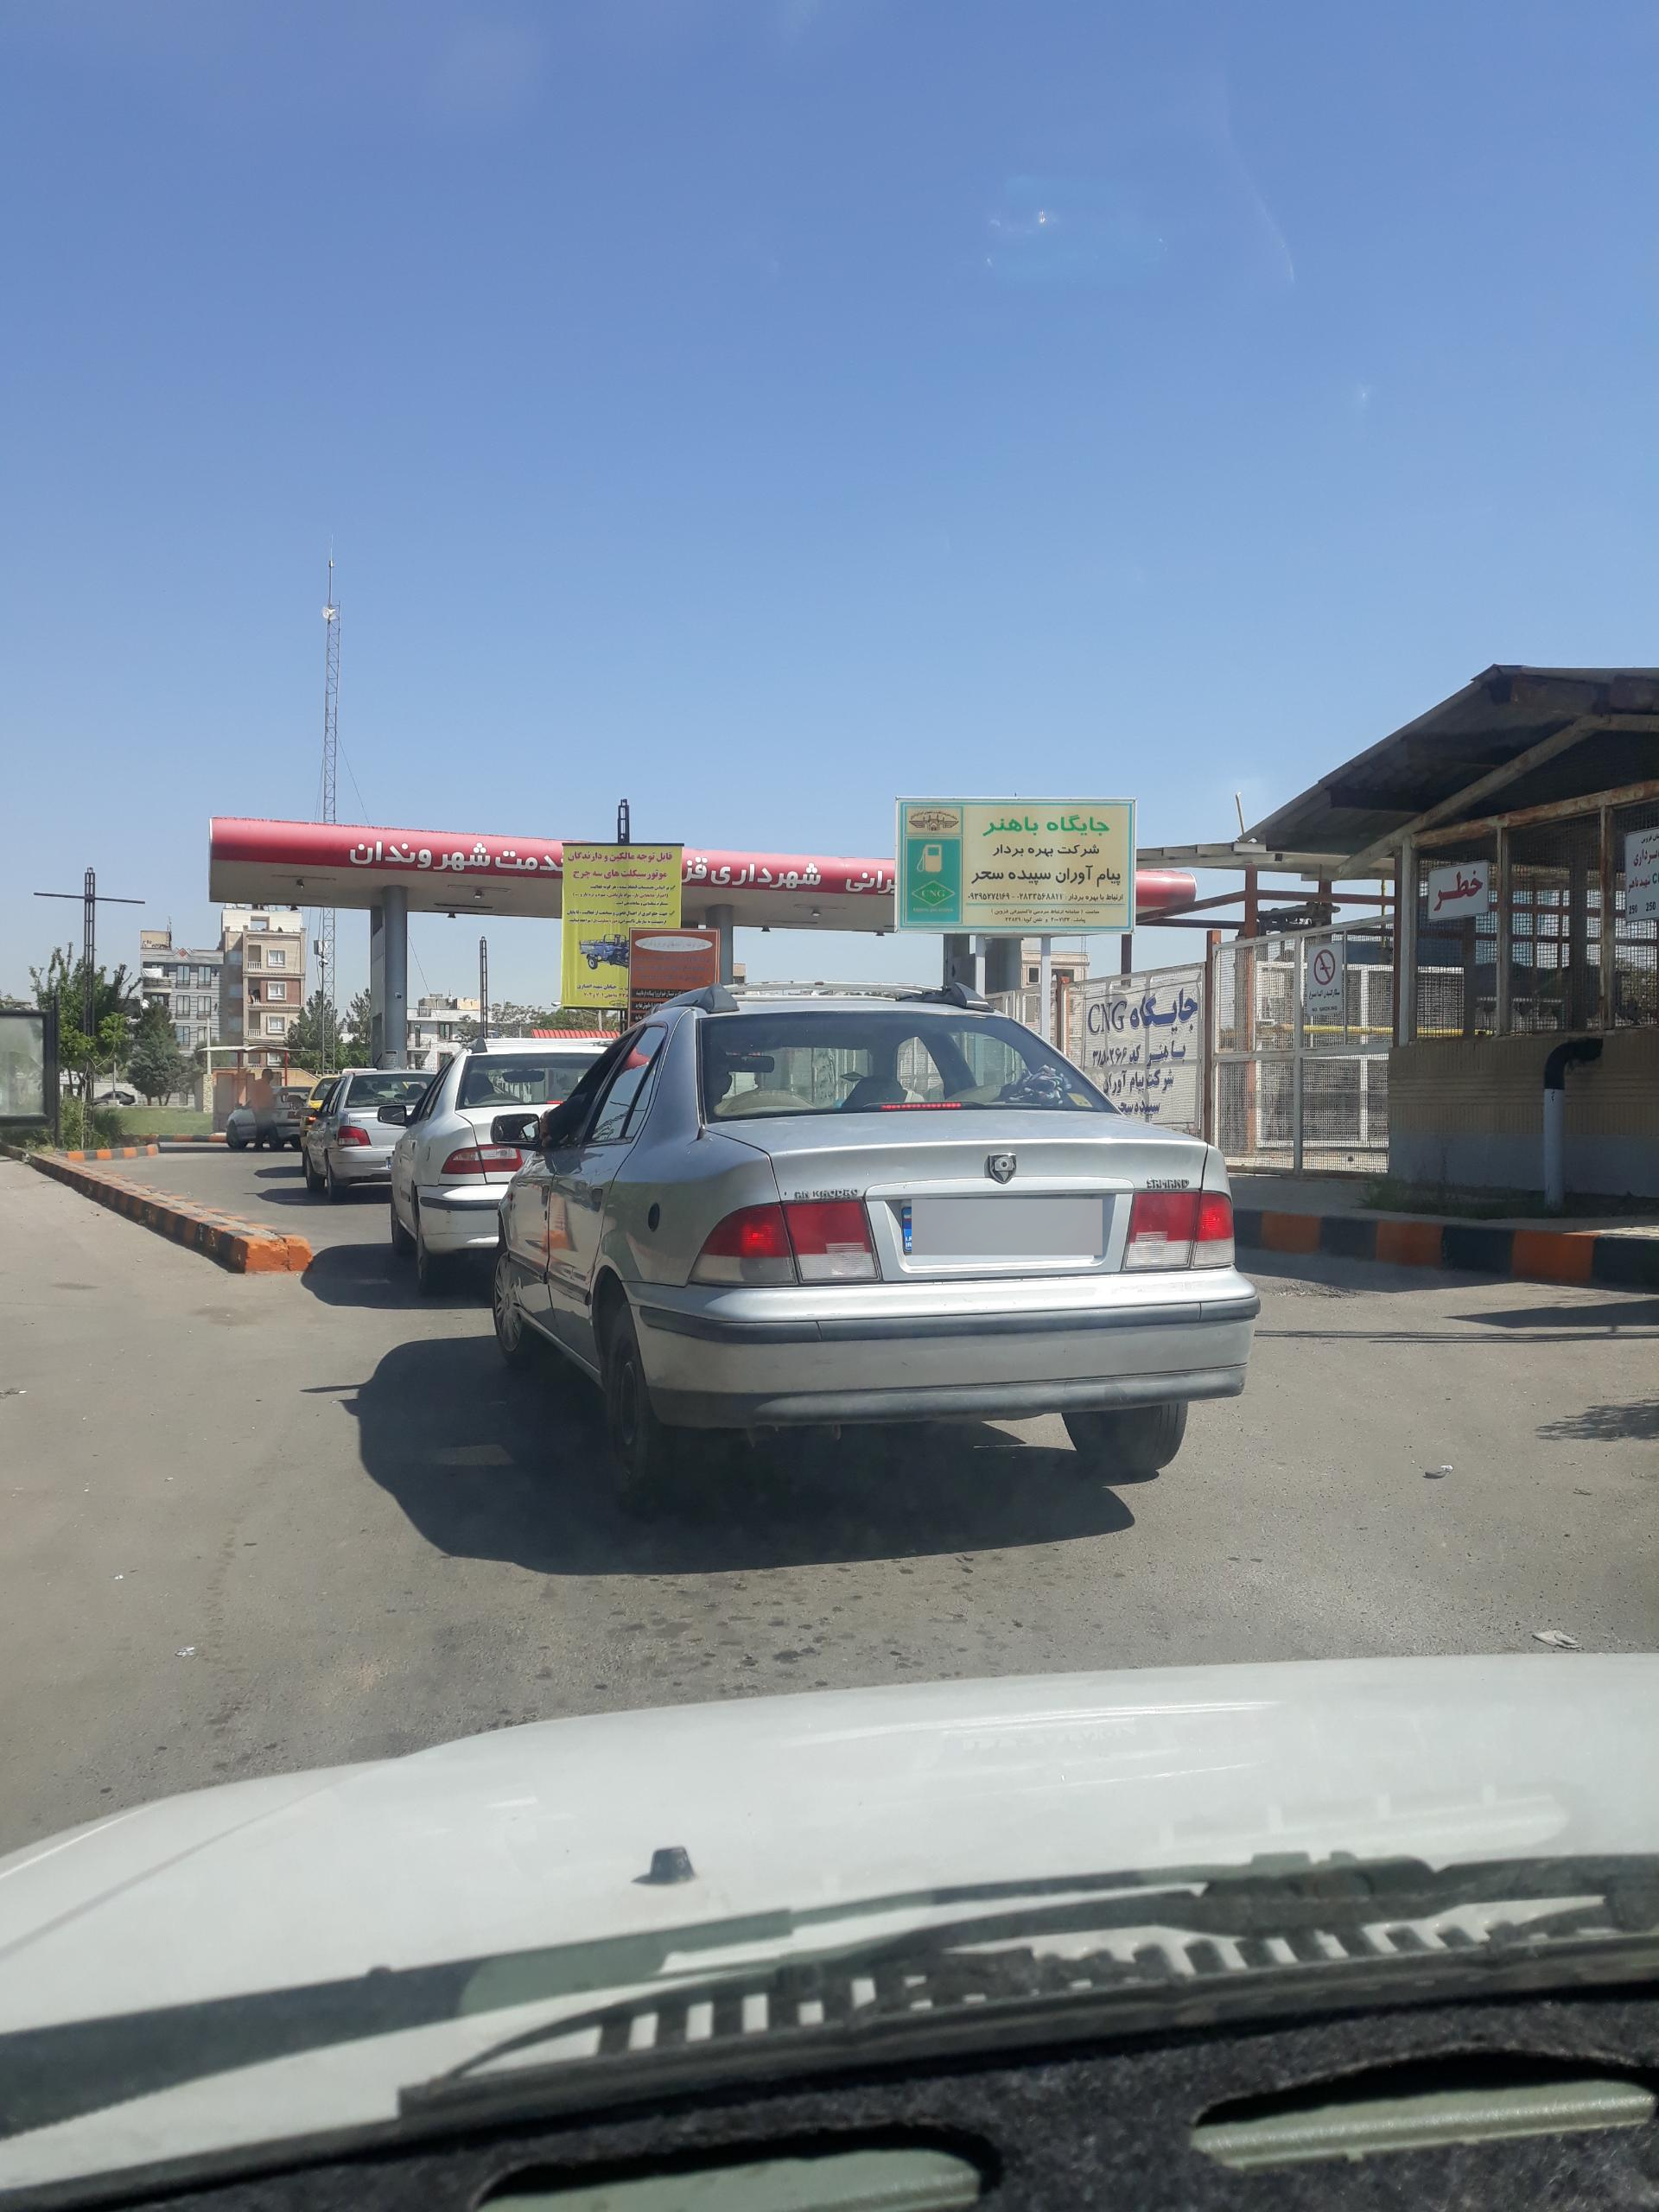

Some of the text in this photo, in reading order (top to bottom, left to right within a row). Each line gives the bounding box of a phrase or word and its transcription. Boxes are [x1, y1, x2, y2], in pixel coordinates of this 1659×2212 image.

[982, 815, 1110, 836] جایگاه باهنر
[349, 842, 492, 872] شهروندان
[993, 843, 1100, 857] شرکت بهره بردار
[681, 856, 709, 882] قز
[710, 862, 822, 889] شهرداری
[971, 865, 1121, 887] پیام آوران سپیده سحر
[1068, 893, 1084, 901] بردار
[1106, 893, 1123, 901] ارتباط
[1433, 870, 1484, 912] خطر
[1629, 904, 1638, 915] 250
[1645, 901, 1656, 912] 250
[1088, 988, 1198, 1035] جایگاه CNG
[1103, 1069, 1174, 1095] شرکت پیام آوران
[1118, 1102, 1133, 1113] سح
[812, 1188, 858, 1198] KHODRO
